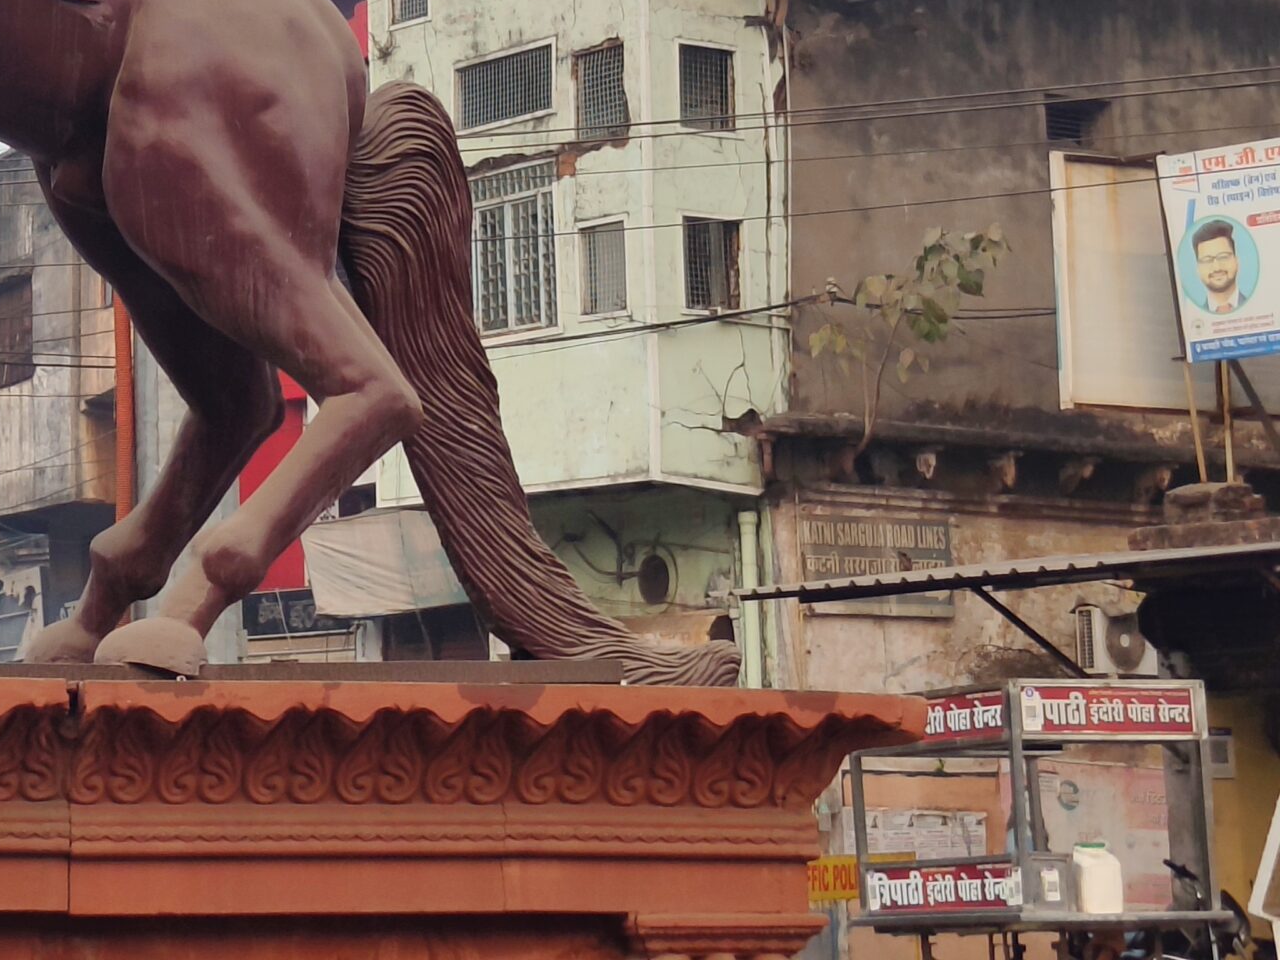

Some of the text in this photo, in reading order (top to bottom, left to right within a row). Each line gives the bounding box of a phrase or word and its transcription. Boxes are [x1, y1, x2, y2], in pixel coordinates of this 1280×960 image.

[803, 521, 834, 545] KATNI
[886, 524, 915, 548] ROAD
[917, 526, 946, 550] LINES
[946, 703, 971, 731] पोहा
[972, 700, 1002, 728] सेन्टर
[1088, 698, 1124, 724] इंदौरी
[1127, 698, 1155, 723] पोहा
[1157, 698, 1190, 723] सेन्टर
[926, 873, 955, 906] इंदौरी
[957, 872, 982, 902] पोहा
